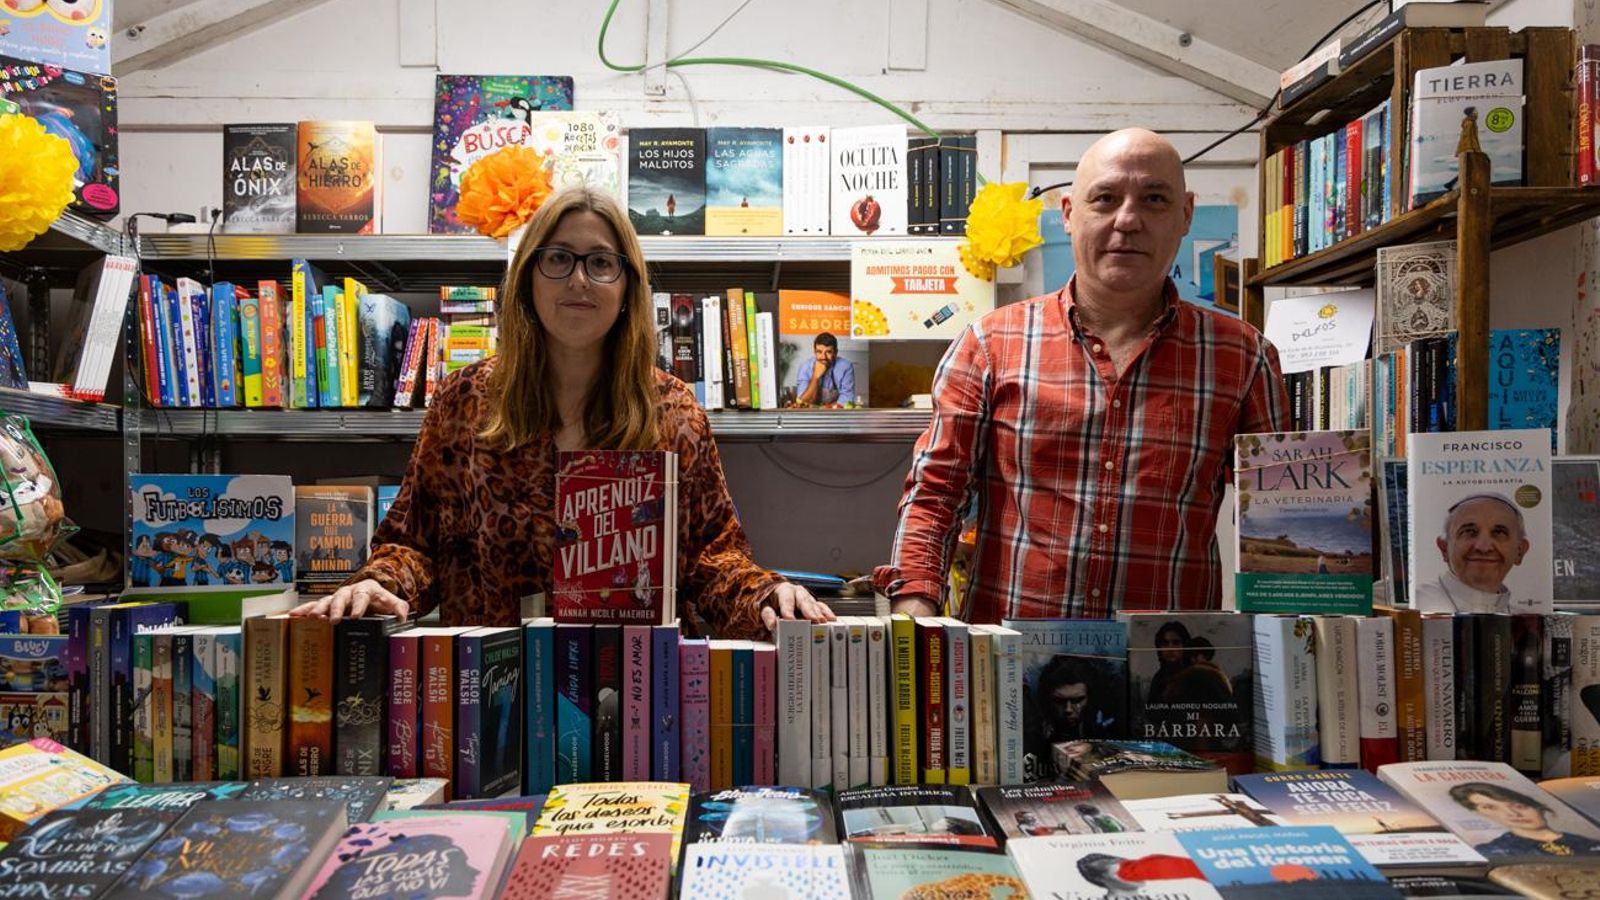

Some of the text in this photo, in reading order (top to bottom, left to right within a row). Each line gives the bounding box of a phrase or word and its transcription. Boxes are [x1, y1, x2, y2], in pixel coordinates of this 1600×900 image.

[1429, 72, 1514, 92] TIERRA
[568, 122, 594, 132] 1080
[639, 150, 695, 158] LOS HIJOS
[714, 150, 776, 158] LAS AGUAS
[840, 147, 898, 167] OCULTA
[231, 157, 287, 171] ALAS DE
[309, 157, 350, 169] ALAS
[639, 160, 694, 169] MALDITOS
[716, 160, 775, 169] SAGRADAS
[234, 174, 282, 196] ÓNIX
[309, 175, 361, 188] HIERRO
[840, 171, 898, 192] NOCHE
[866, 265, 955, 276] ADMITIMOS PAGOS CON
[904, 278, 946, 292] TARJETA
[1497, 335, 1515, 428] AQUIL
[1272, 447, 1332, 463] SARAH
[1442, 440, 1522, 453] FRANCISCO
[1421, 458, 1544, 476] ESPERANZA
[1254, 461, 1351, 492] LARK
[187, 488, 209, 498] LOS
[562, 472, 657, 523] APRENDIZ
[1274, 496, 1354, 505] VETERINARIA
[326, 503, 337, 512] LA
[310, 514, 354, 526] GUERRA
[593, 510, 620, 539] DEL
[324, 527, 339, 536] QUE
[309, 533, 354, 550] CAMBIÓ
[560, 524, 658, 580] VILLANO
[310, 558, 352, 572] MUNDO
[558, 609, 656, 619] HANNAH NICOLE MAEHRER
[1021, 633, 1123, 646] CALLIE HART
[1412, 637, 1420, 671] ARTURO
[1580, 638, 1589, 665] negro
[348, 640, 356, 684] REBECCA
[358, 644, 366, 681] YARROS
[632, 635, 642, 701] NO ES AMOR
[930, 637, 941, 704] SECRETO ASISTENTA
[954, 641, 964, 699] ASISTENTA VIGILA
[898, 636, 910, 711] LA MUJER DE ARRIBA
[1376, 630, 1388, 734] JORGE MOLIST EL
[394, 668, 402, 704] WALSH
[403, 668, 412, 704] CHLOE
[429, 666, 438, 703] WALSH
[438, 666, 448, 703] CHLOE
[460, 668, 469, 705] WALSH
[470, 668, 480, 704] CHLOE
[482, 665, 520, 708] Taming
[1442, 638, 1454, 748] JULIA NAVARRO
[1005, 687, 1018, 732] Heartless
[1186, 712, 1200, 720] MI
[1406, 703, 1414, 714] LA
[900, 724, 910, 747] FREIDA
[1144, 721, 1241, 738] BÁRBARA
[425, 720, 451, 772] Keeping
[930, 728, 940, 750] FREIDA
[954, 728, 964, 750] FREIDA
[1416, 731, 1424, 747] ISLA
[392, 744, 400, 755] 13
[426, 748, 434, 760] 13
[1413, 770, 1511, 783] LA CARTERA
[838, 788, 882, 796] Almudena
[1000, 784, 1076, 795] Los colmillos
[1004, 790, 1054, 799] del lince
[1286, 780, 1357, 794] AHORA
[112, 792, 207, 808] LEATHER
[840, 791, 898, 802] ESCALERA
[1288, 790, 1378, 804] TE TOCA
[1292, 801, 1400, 816] SER FELIZ
[541, 842, 650, 860] REDES
[1048, 838, 1146, 850] Virginia Feito
[1197, 842, 1348, 860] Una historia
[0, 858, 130, 876] SOMBRAS
[355, 849, 456, 875] TODAS
[696, 855, 838, 869] INVISIBLE
[1214, 854, 1352, 870] del Kronen
[348, 865, 446, 892] LAS COSAS
[351, 874, 448, 900] QUE NO VI
